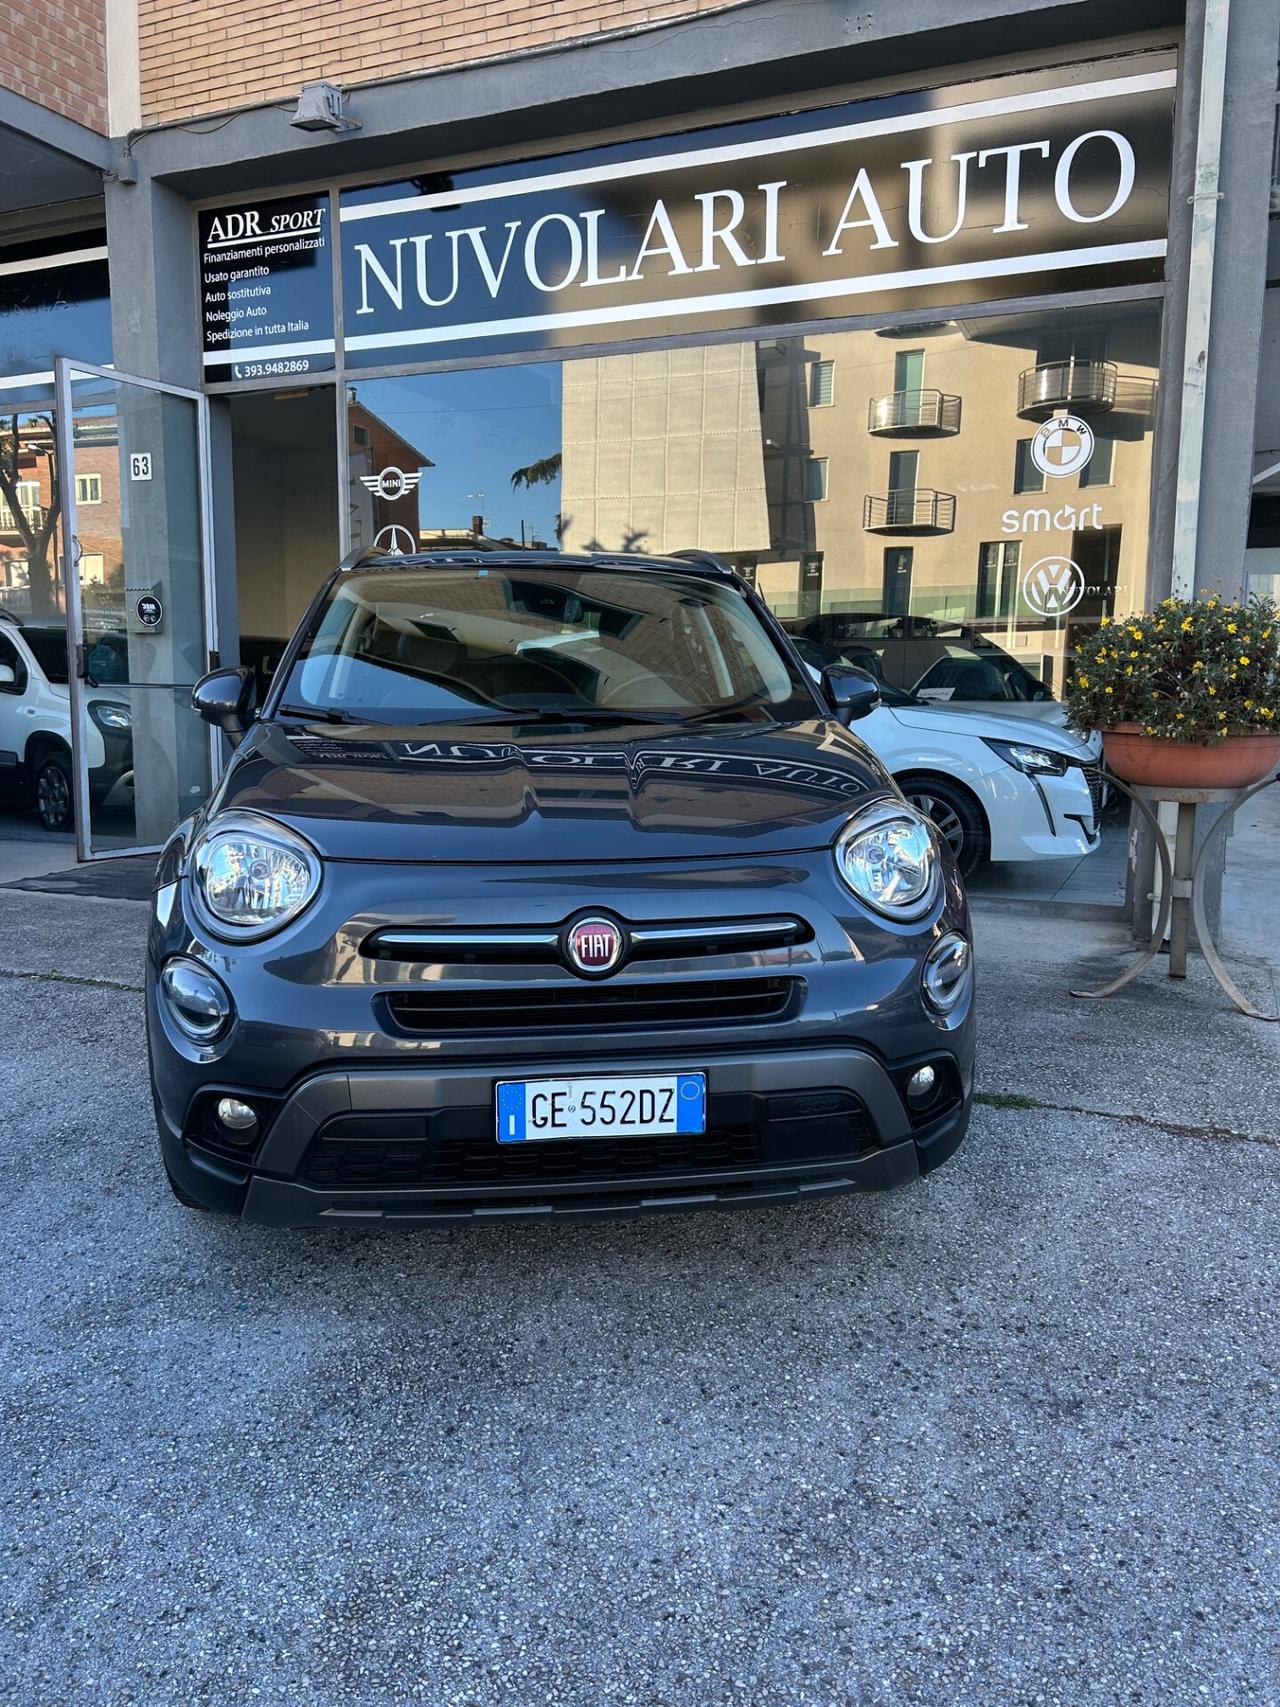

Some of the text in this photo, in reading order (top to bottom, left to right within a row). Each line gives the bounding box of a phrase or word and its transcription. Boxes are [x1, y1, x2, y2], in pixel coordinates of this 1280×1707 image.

[207, 208, 326, 243] ADR SPORT
[354, 129, 1137, 315] NUVOLARI AUTO
[203, 236, 325, 264] Finanziamenti personalizzati
[204, 265, 270, 284] Usato garantito
[205, 285, 272, 303] Auto sostitutiva
[206, 306, 268, 325] Noleggio Auto
[206, 320, 309, 344] Spedizione in tutta Italia
[244, 359, 310, 378] 393.9482869
[133, 456, 149, 477] 63
[382, 479, 401, 489] MINI
[1000, 503, 1104, 535] smart
[580, 933, 612, 958] FIAT
[531, 1091, 567, 1129] GE
[580, 1088, 675, 1126] 552DZ
